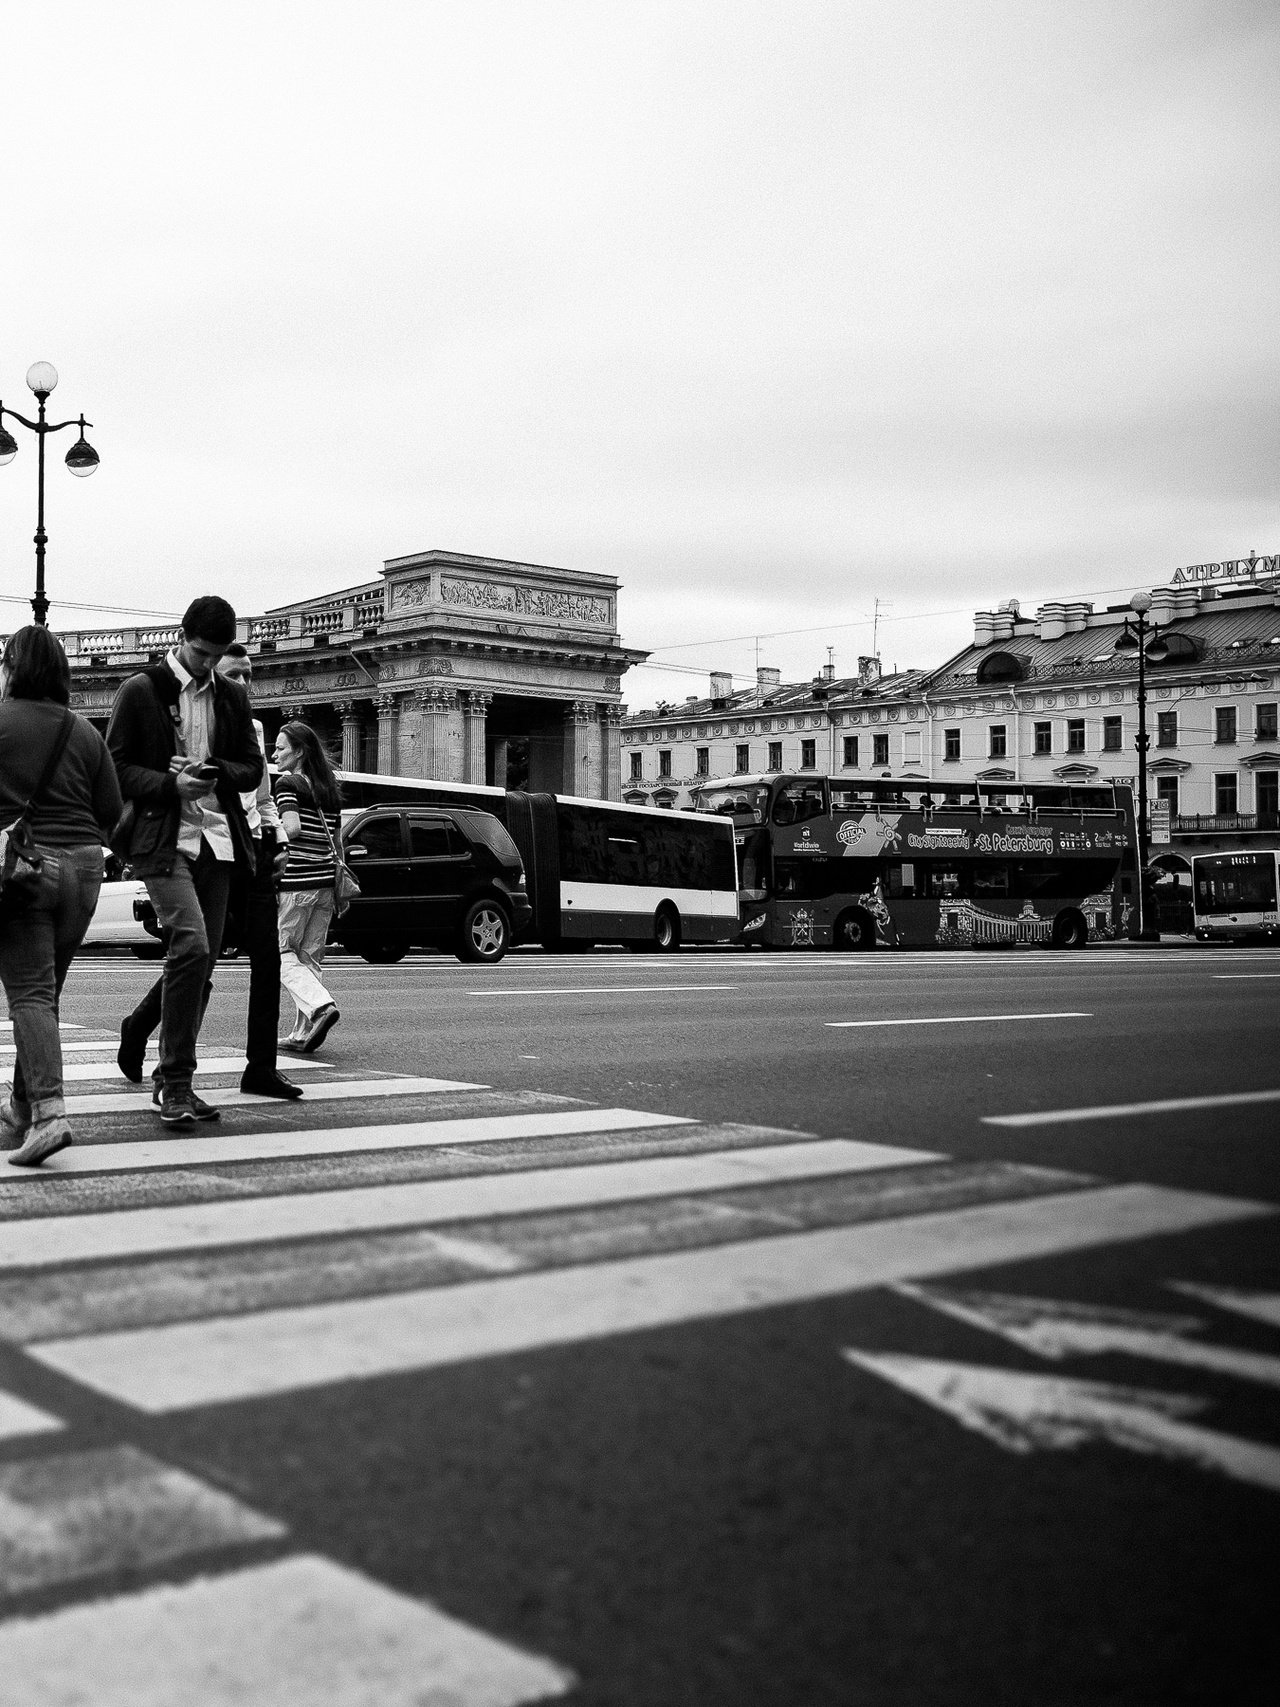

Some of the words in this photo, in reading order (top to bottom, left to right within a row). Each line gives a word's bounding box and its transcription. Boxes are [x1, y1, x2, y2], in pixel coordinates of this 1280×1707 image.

[1170, 554, 1280, 584] АТРИУМ
[839, 827, 865, 840] OFFICIAL
[978, 833, 992, 851] St
[992, 833, 1054, 854] Petersburg
